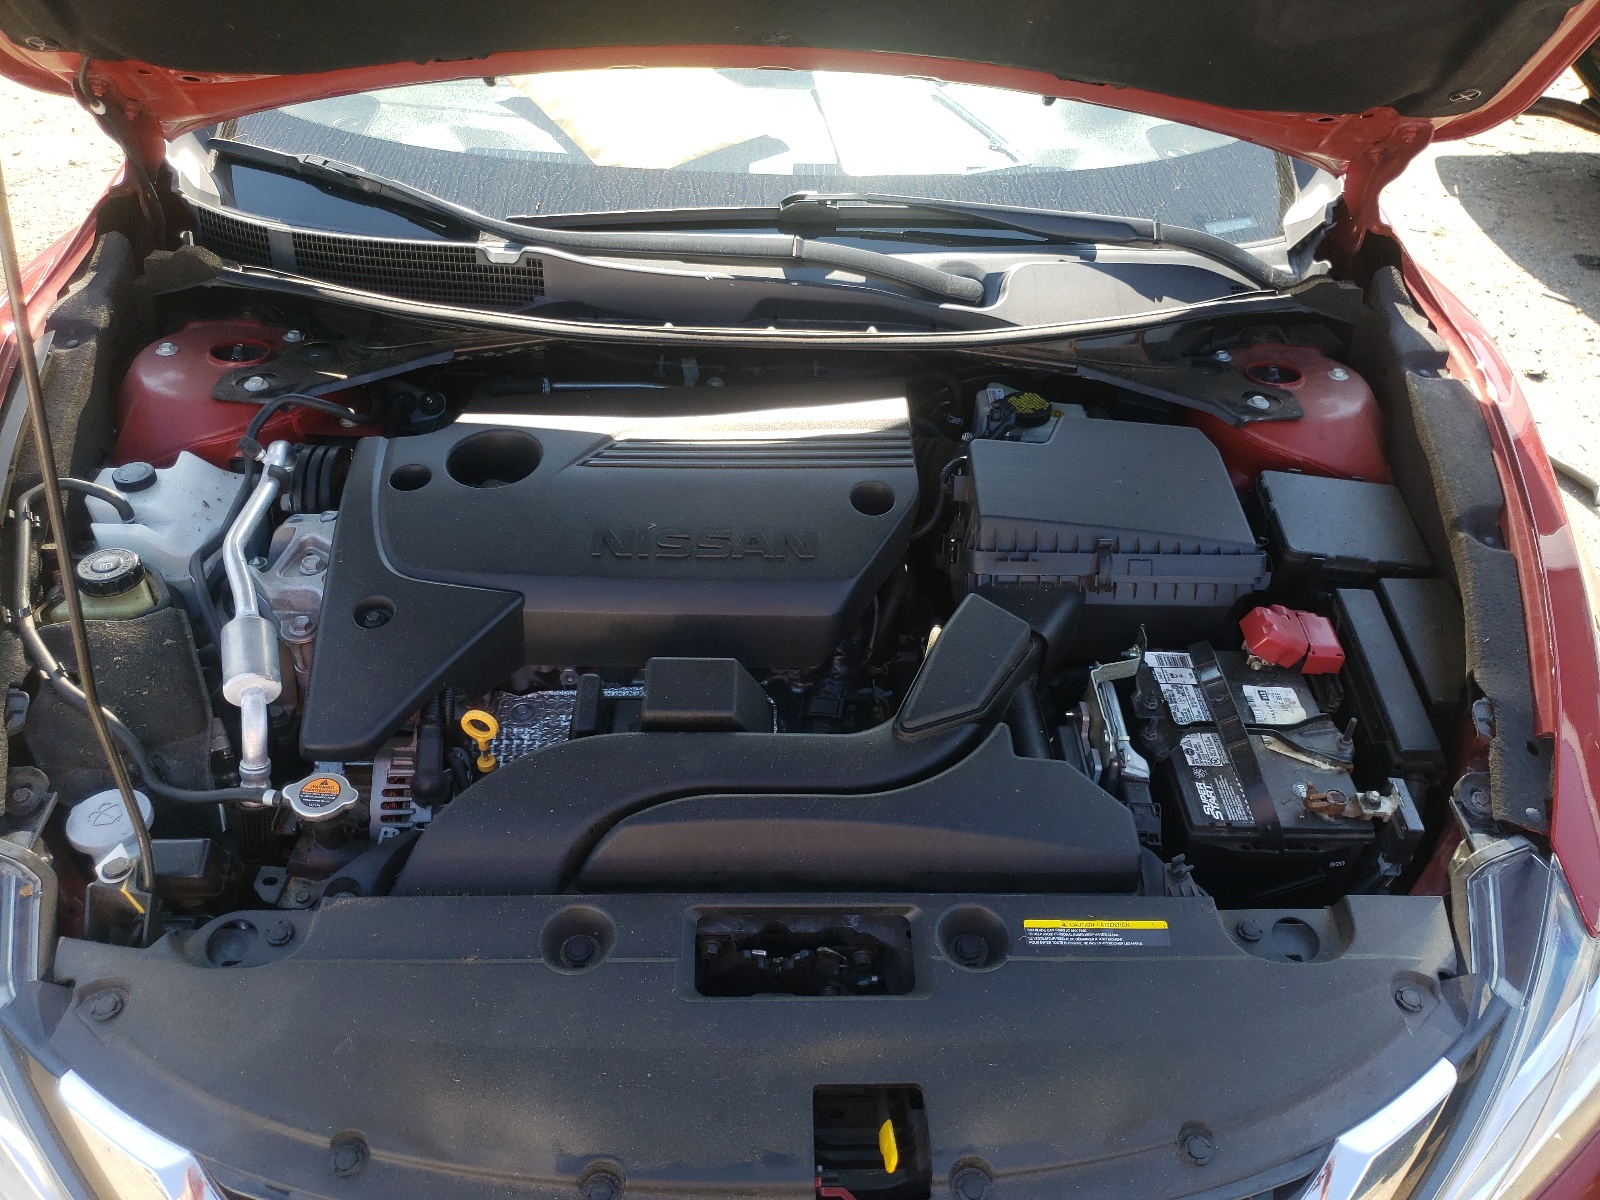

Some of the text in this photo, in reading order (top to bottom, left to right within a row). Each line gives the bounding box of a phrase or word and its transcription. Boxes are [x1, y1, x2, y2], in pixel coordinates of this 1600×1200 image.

[591, 528, 819, 558] NISSAN
[1195, 781, 1211, 816] SUPER
[1203, 782, 1225, 821] START
